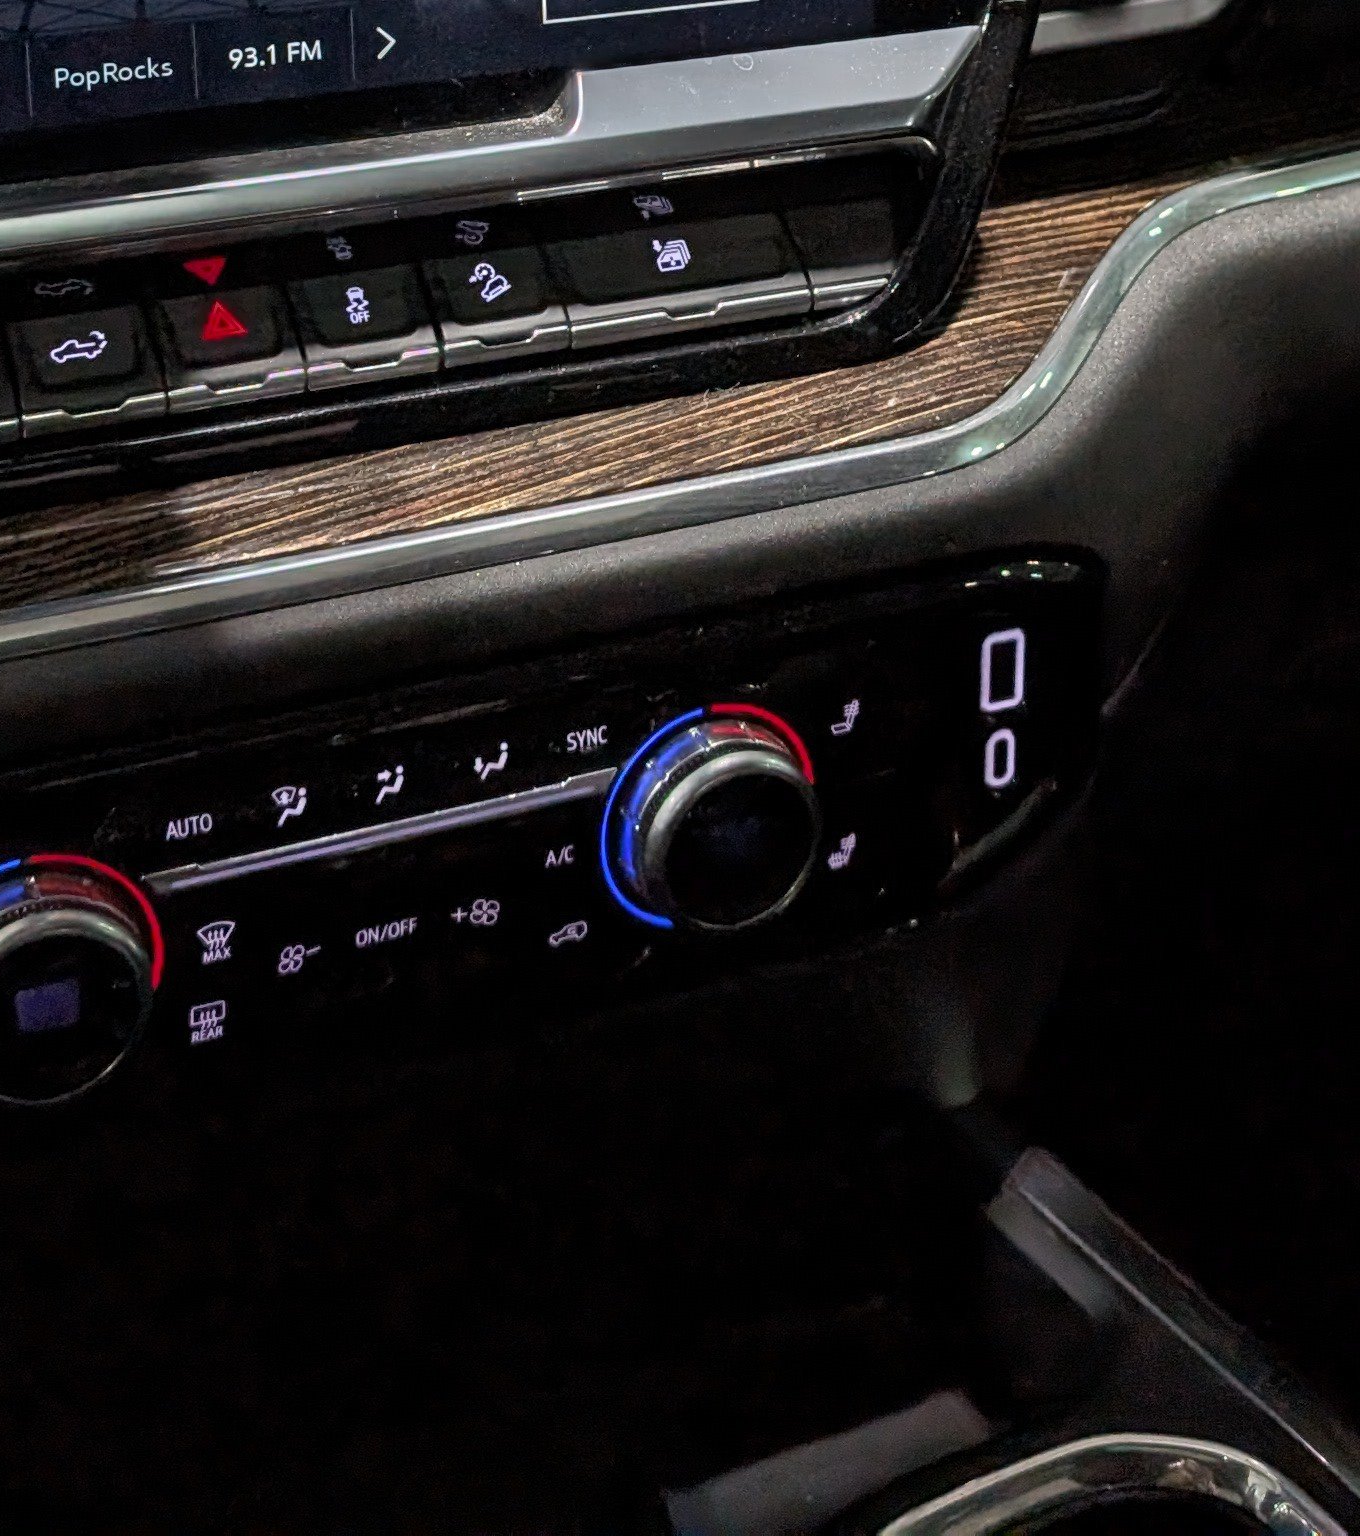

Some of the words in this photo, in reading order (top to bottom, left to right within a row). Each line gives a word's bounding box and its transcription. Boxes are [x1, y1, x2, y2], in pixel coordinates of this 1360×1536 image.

[228, 43, 277, 70] 93.1
[287, 39, 322, 63] FM
[349, 310, 371, 324] OFF
[566, 725, 608, 752] SYNC
[165, 813, 213, 841] AUTO
[544, 845, 574, 867] A/C
[355, 917, 418, 947] ON/OFF
[202, 945, 232, 963] MAX
[190, 1024, 224, 1043] REAR
